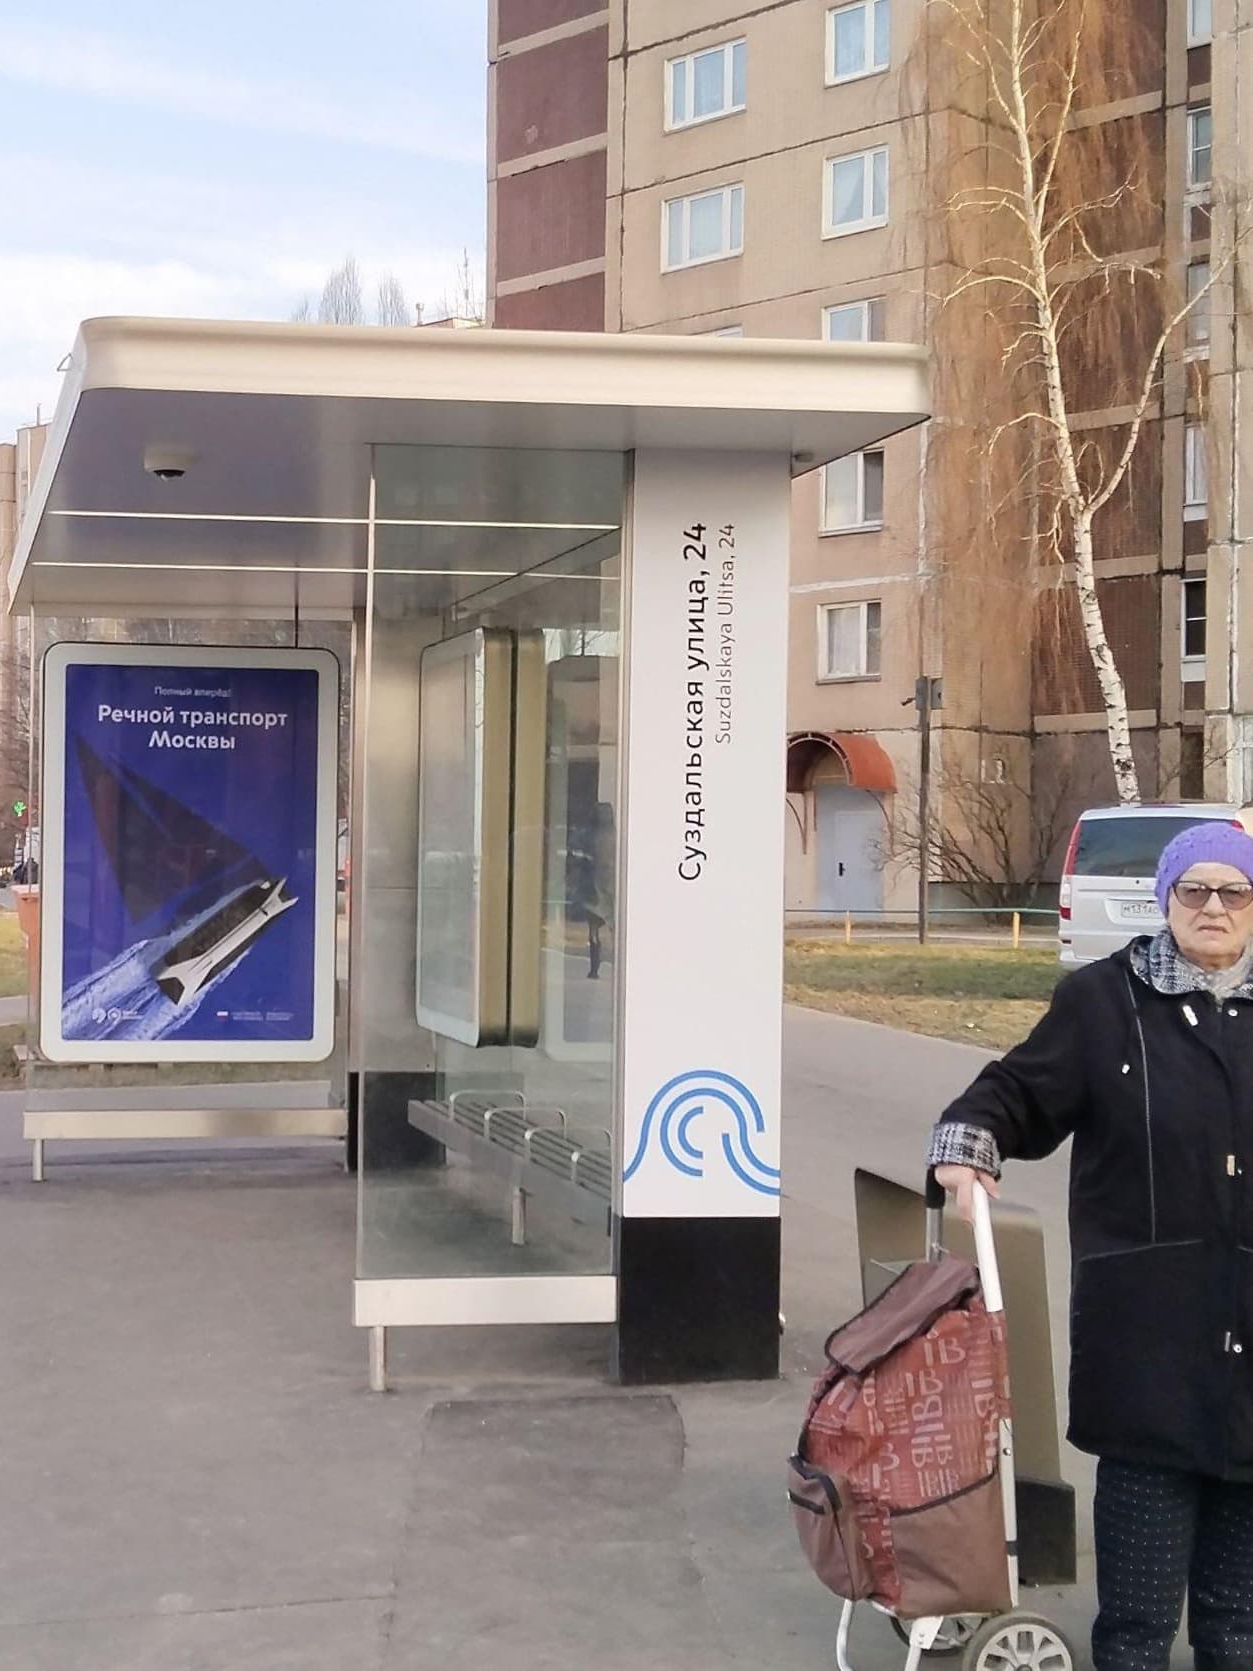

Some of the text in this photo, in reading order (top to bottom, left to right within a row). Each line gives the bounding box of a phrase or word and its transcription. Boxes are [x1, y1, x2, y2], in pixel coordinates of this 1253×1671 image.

[714, 523, 737, 744] Suzdalskaya Ulitsa, 24
[97, 704, 288, 730] Речной транспорт
[148, 730, 235, 750] Москвы
[677, 522, 711, 881] Суздальская улица, 24
